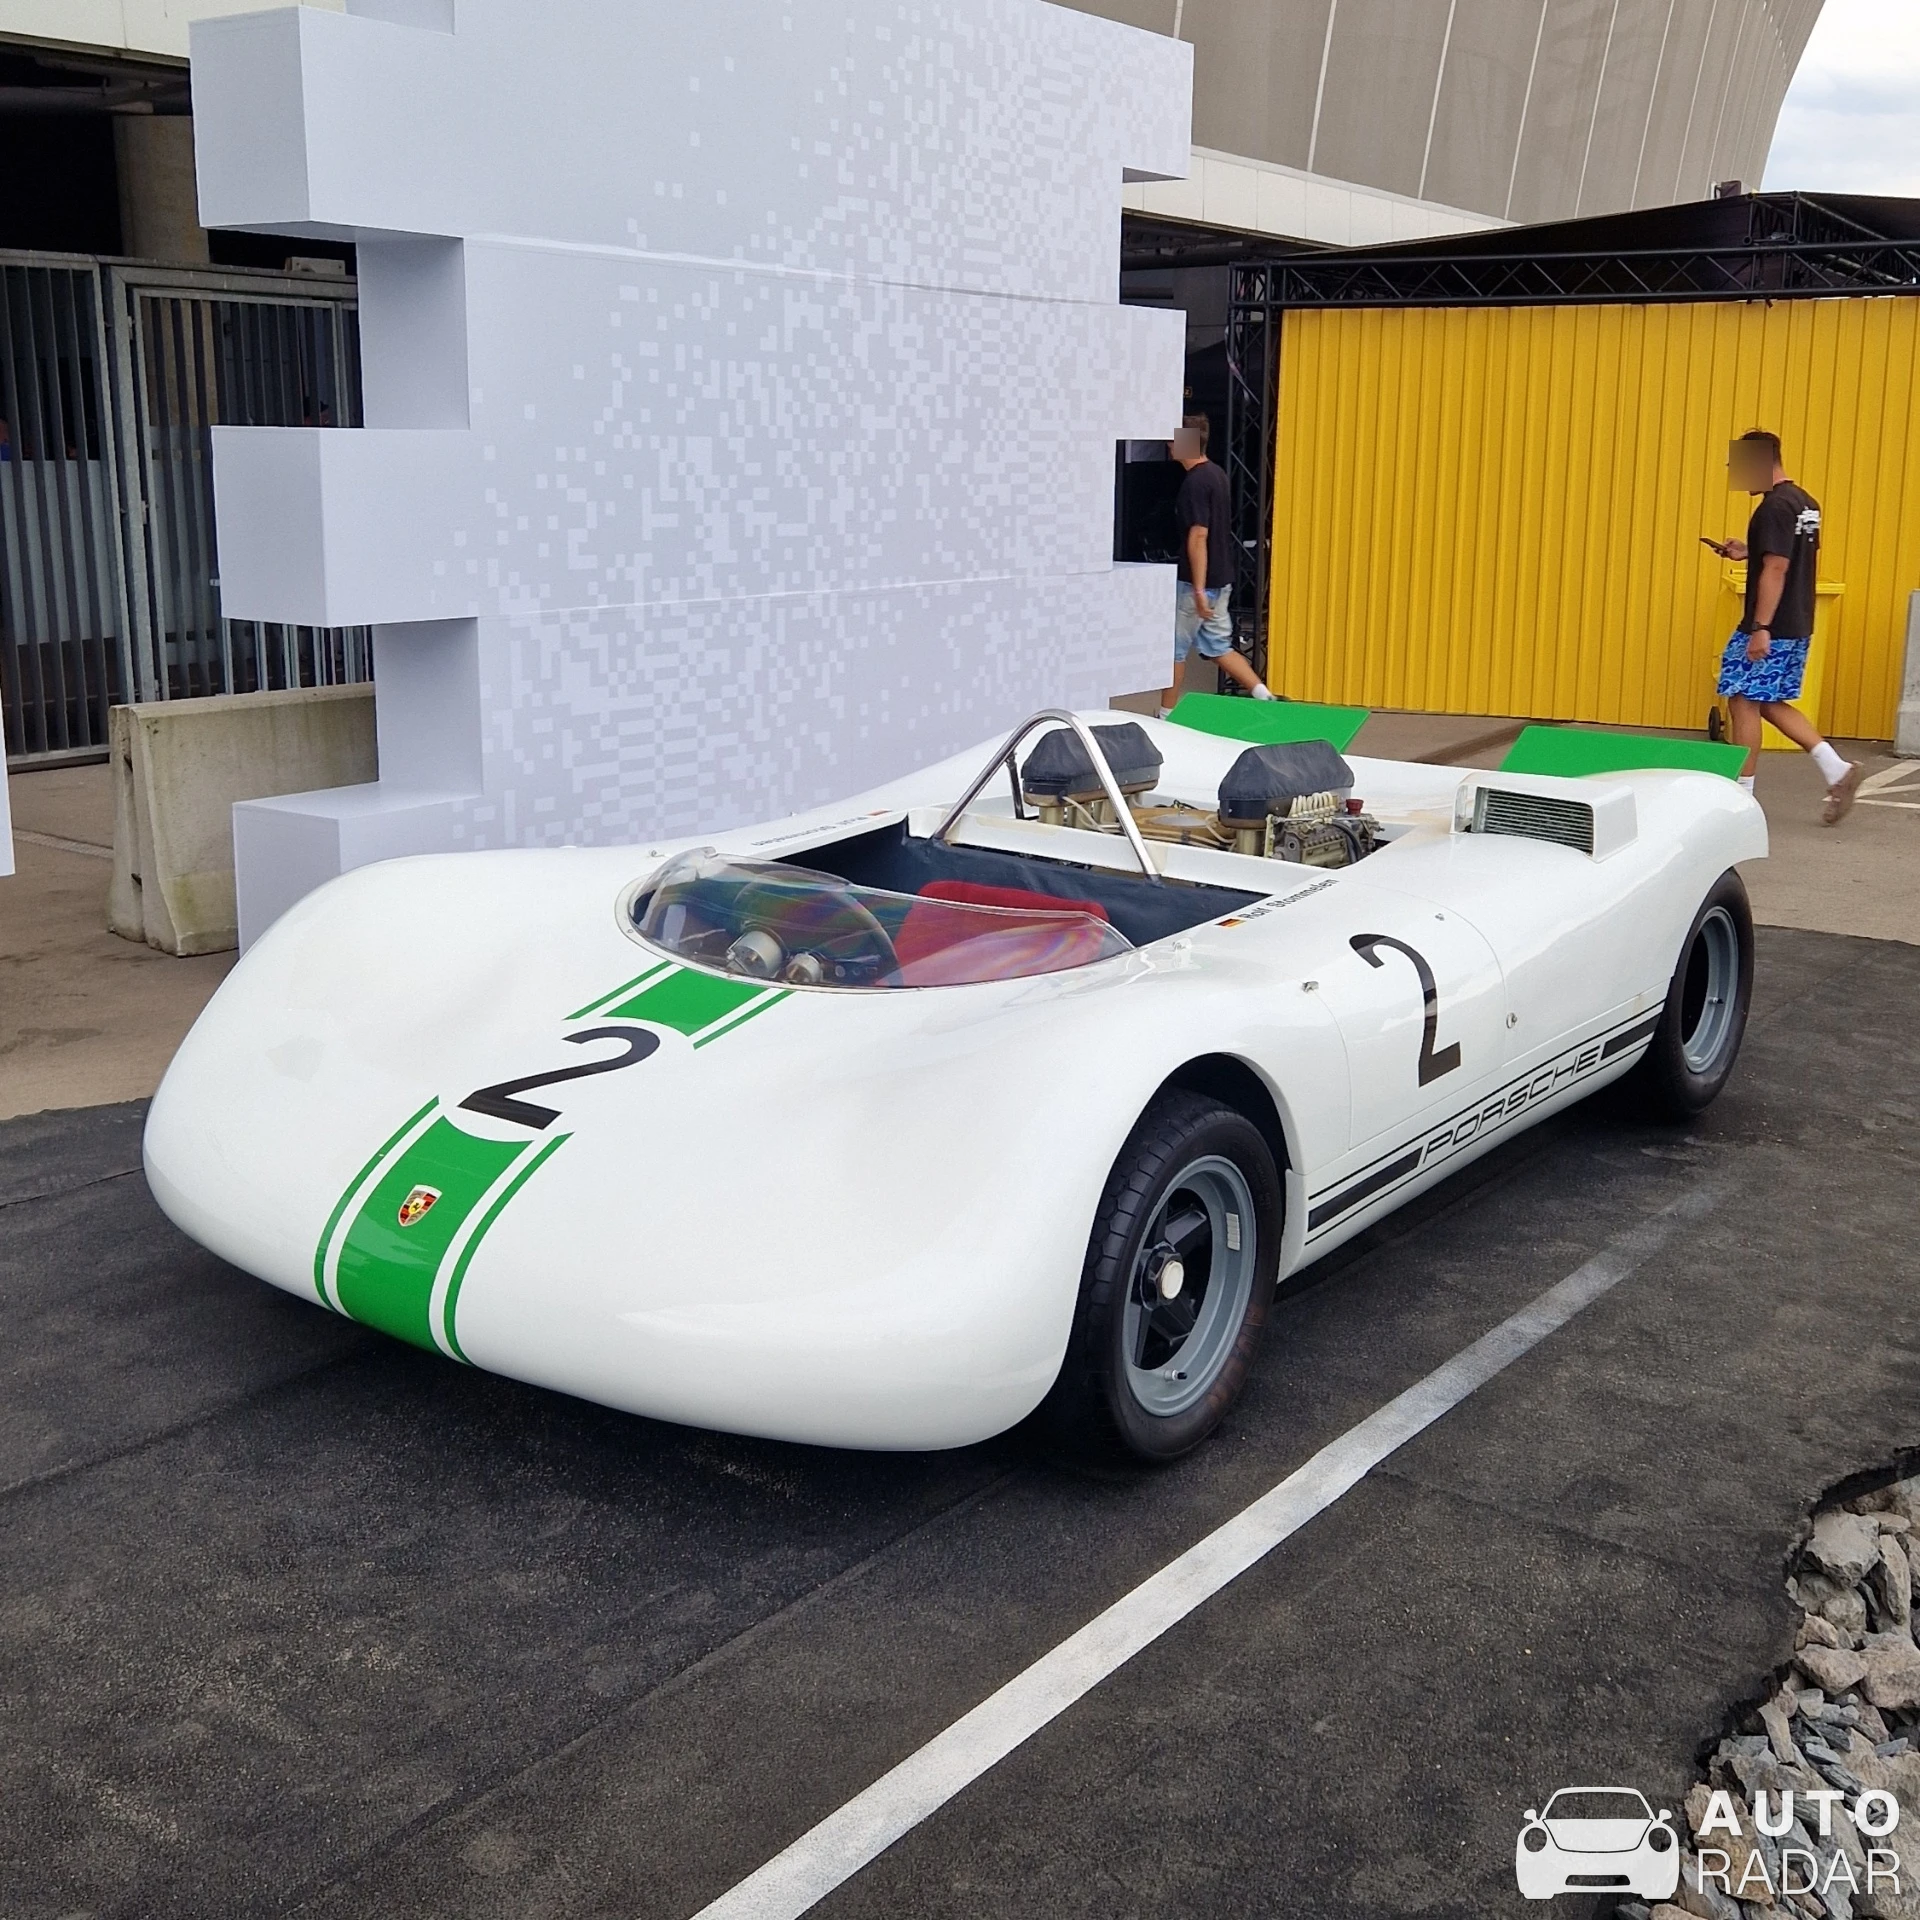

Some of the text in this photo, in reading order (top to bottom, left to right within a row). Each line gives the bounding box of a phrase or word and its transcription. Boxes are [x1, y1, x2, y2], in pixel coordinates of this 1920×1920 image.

[1349, 933, 1462, 1089] 2
[456, 1025, 661, 1131] 2
[1422, 1044, 1601, 1164] PORSCHE
